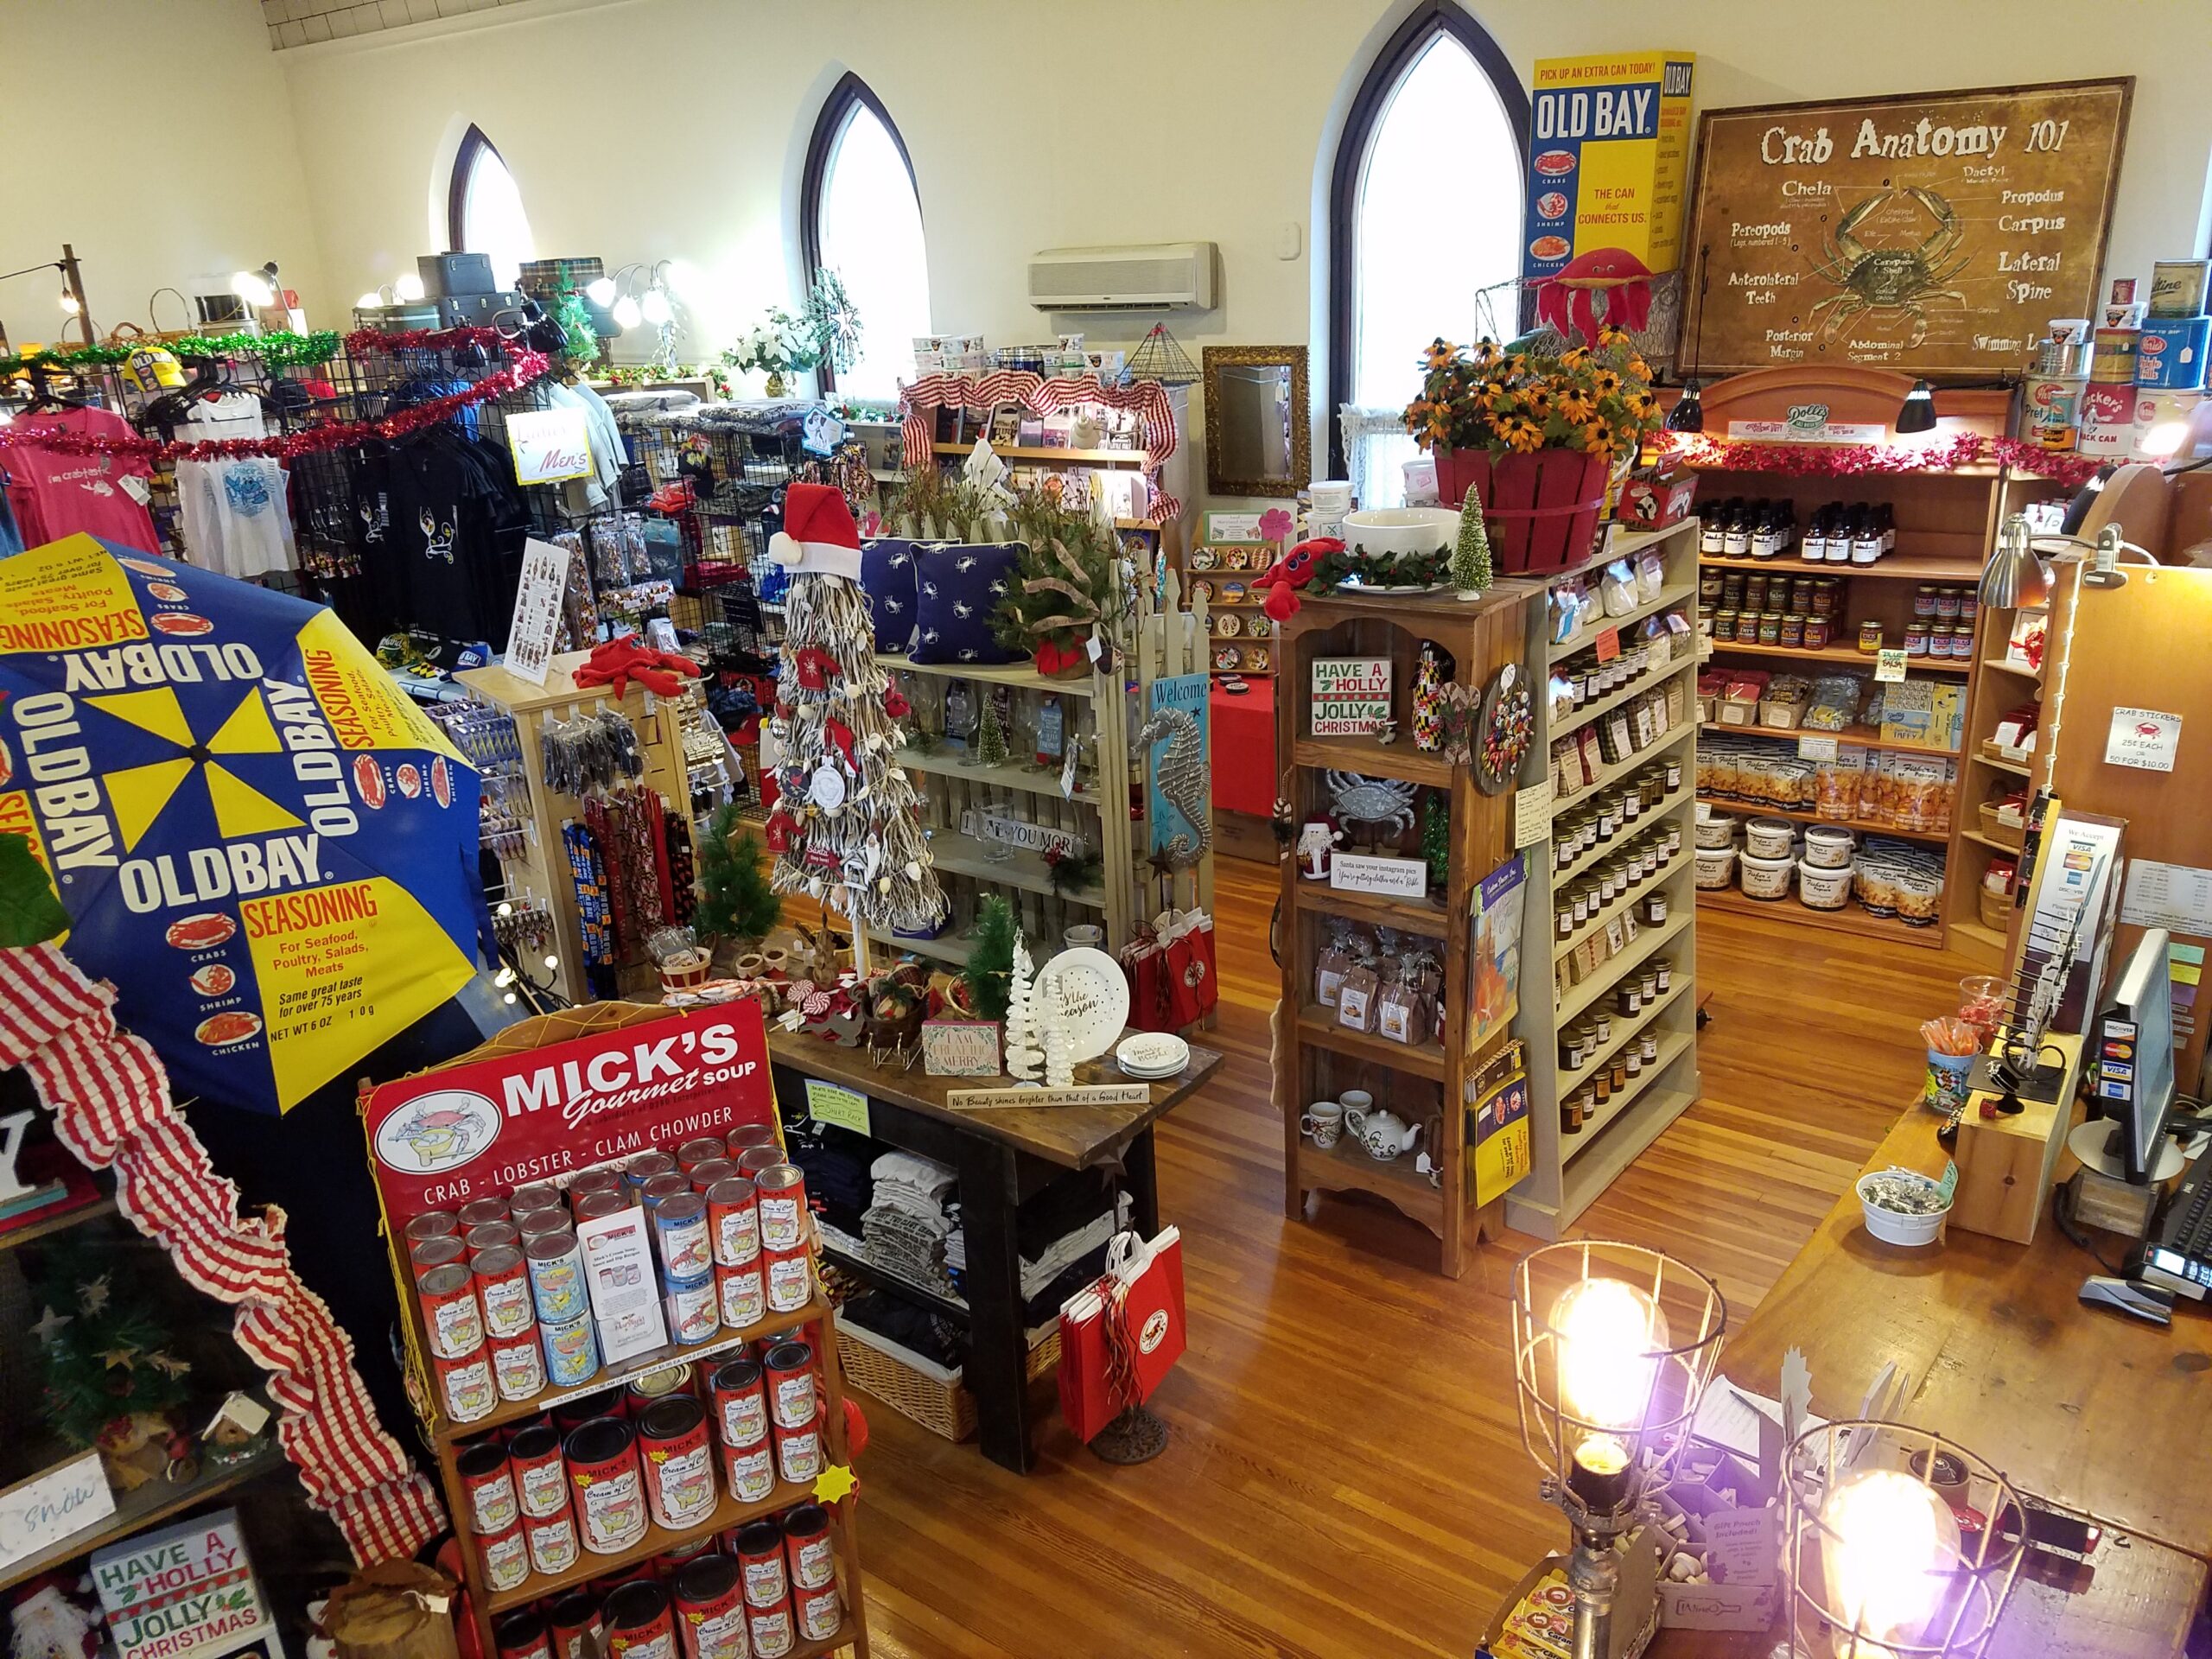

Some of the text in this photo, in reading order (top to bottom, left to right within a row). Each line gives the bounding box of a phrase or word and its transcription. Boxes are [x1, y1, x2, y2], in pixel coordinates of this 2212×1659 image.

[1540, 63, 1656, 80] PICK UP AN EXTRA CAN TODAY!
[1664, 67, 1676, 94] OLD
[1536, 92, 1588, 139] OLD
[1761, 118, 2071, 166] Crab Anatomy 101
[1963, 165, 2005, 178] Dactyl
[1594, 188, 1635, 200] THE CAN
[1782, 181, 1833, 197] Chela
[2001, 189, 2064, 206] Propodus
[1578, 213, 1629, 225] CONNECTS
[1998, 215, 2066, 235] Carpus
[1731, 221, 1791, 239] Pereopods
[1998, 251, 2063, 272] Lateral
[1728, 272, 1799, 287] Anterolateral
[1745, 290, 1777, 305] Teeth
[2006, 279, 2052, 304] Spine
[1765, 329, 1814, 342] Posterior
[1847, 339, 1904, 350] Abdominal
[1972, 334, 2022, 356] Swimming
[132, 353, 152, 369] OLD
[1770, 345, 1804, 361] Margin
[1847, 352, 1902, 363] Segment 2
[2099, 434, 2117, 442] CAN
[539, 448, 587, 473] Men's
[85, 599, 107, 607] For
[1315, 663, 1383, 677] HAVE A
[1155, 681, 1207, 703] Welcome
[1336, 678, 1388, 692] HOLLY
[305, 649, 375, 748] SEASONING
[1314, 702, 1369, 720] JOLLY
[2114, 709, 2182, 722] CRAB STICKERS
[1314, 720, 1386, 734] CHRISTMAS
[2139, 741, 2164, 751] EACH
[2109, 755, 2170, 770] 50 FOR $10.00
[385, 766, 396, 794] CRABS
[422, 764, 431, 798] SHRIMP
[2073, 844, 2092, 853] VISA
[1339, 861, 1355, 869] Santa
[1379, 865, 1405, 874] instagram
[1746, 868, 1771, 880] Fisher's
[1806, 879, 1830, 890] Fisher's
[244, 885, 378, 938] SEASONING
[279, 930, 358, 954] For Seafood,
[191, 949, 227, 963] CRABS
[273, 942, 368, 970] Poultry, Salads,
[305, 962, 344, 978] Meats
[279, 976, 363, 1005] Same great taste
[200, 996, 243, 1012] SHRIMP
[278, 989, 362, 1018] for over 75 years
[270, 1015, 332, 1042] NET WT 6 OZ
[212, 1040, 260, 1056] CHICKEN
[502, 1024, 739, 1117] MICK'S
[943, 1057, 981, 1068] MERRY
[2107, 1065, 2127, 1076] VISA
[562, 1061, 756, 1130] Gourmet SOUP
[952, 1096, 963, 1107] No
[967, 1096, 993, 1108] Beauty
[995, 1096, 1016, 1105] shines
[1019, 1094, 1045, 1106] brighter
[1047, 1094, 1063, 1103] than
[1065, 1093, 1079, 1103] that
[1082, 1091, 1090, 1102] of
[1098, 1090, 1118, 1102] Good
[1122, 1090, 1142, 1101] Heart
[424, 1106, 733, 1205] CRAB LOBSTER CLAM CHOWDER
[673, 1216, 699, 1227] MICK'S
[607, 1228, 635, 1241] MICK'S
[537, 1258, 564, 1268] MICK'S
[685, 1279, 709, 1290] MICK'S
[554, 1319, 581, 1332] MICK'S
[575, 1386, 594, 1398] MICK'S
[594, 1380, 616, 1392] CREAM
[624, 1371, 641, 1382] CRAB
[641, 1366, 658, 1376] SOUP
[709, 1344, 727, 1353] $11.00
[663, 1433, 702, 1454] MICK'S
[588, 1459, 627, 1478] MICK'S
[661, 1461, 696, 1476] Cream of
[587, 1475, 636, 1499] Cream of Crab
[24, 1481, 95, 1533] snow
[1714, 1519, 1761, 1530] Gift Pouch
[1715, 1529, 1758, 1538] Included!
[205, 1532, 226, 1554] A
[99, 1543, 190, 1589] HAVE
[146, 1548, 238, 1595] HOLLY
[699, 1593, 736, 1615] MICK'S
[121, 1595, 213, 1648] JOLLY
[126, 1609, 257, 1659] CHRISTMAS
[623, 1621, 663, 1642] MICK'S
[698, 1625, 724, 1637] Cream
